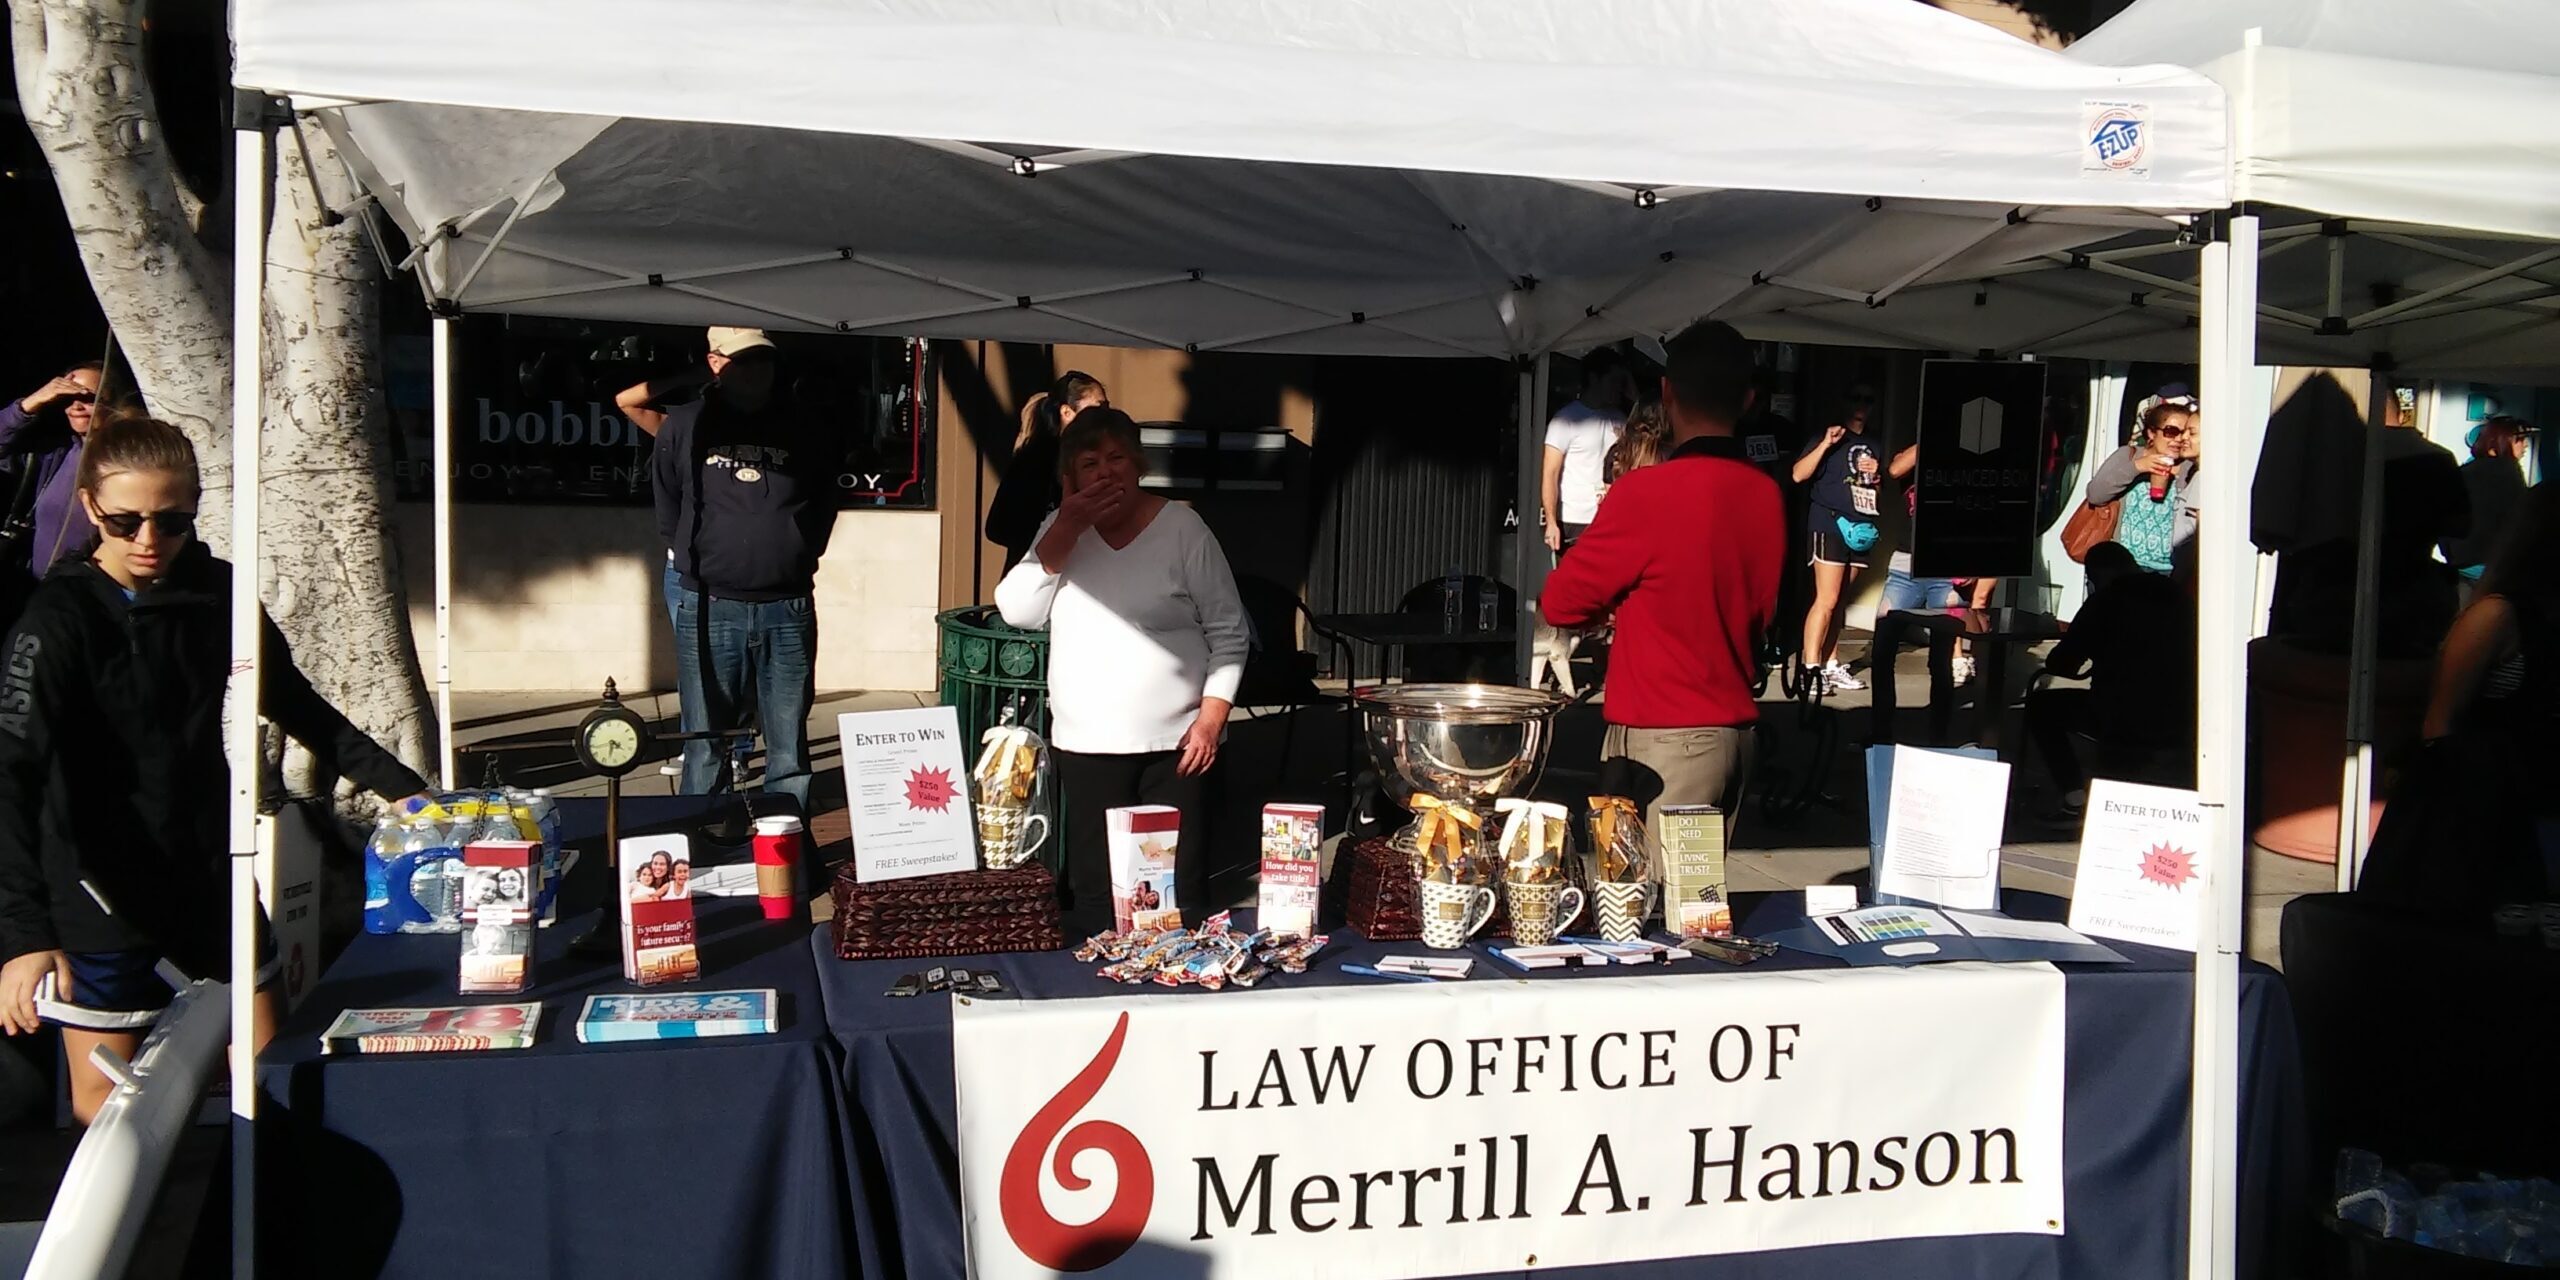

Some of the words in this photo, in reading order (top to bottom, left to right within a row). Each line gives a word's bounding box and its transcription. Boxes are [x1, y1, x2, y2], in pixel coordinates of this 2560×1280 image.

[1925, 468, 1999, 487] BALANCED
[2002, 468, 2030, 487] BOX
[0, 632, 42, 739] ASICS
[856, 731, 897, 747] ENTER
[917, 727, 945, 741] WIN
[917, 790, 941, 802] Value
[2104, 799, 2147, 817] ENTER
[1678, 817, 1693, 827] DO
[1679, 829, 1702, 838] NEED
[1679, 842, 1686, 850] A
[875, 858, 900, 870] FREE
[901, 851, 959, 870] Sweepstakes!
[1679, 853, 1709, 863] LIVING
[1265, 861, 1283, 871] How
[1284, 862, 1298, 871] did
[1298, 864, 1314, 874] you
[1679, 865, 1710, 875] TRUST?
[2152, 864, 2176, 880] Value
[1271, 873, 1288, 882] take
[1289, 873, 1309, 883] title?
[2089, 915, 2114, 928] FREE
[644, 924, 662, 936] your
[640, 936, 663, 947] future
[421, 1006, 526, 1034] 18
[1198, 1042, 1376, 1112] LAW
[1406, 1029, 1679, 1100] OFFICE
[1708, 1022, 1803, 1084] OF
[1190, 1132, 1531, 1242] Merrill
[1562, 1131, 1651, 1221] A.
[1685, 1122, 2024, 1209] Hanson
